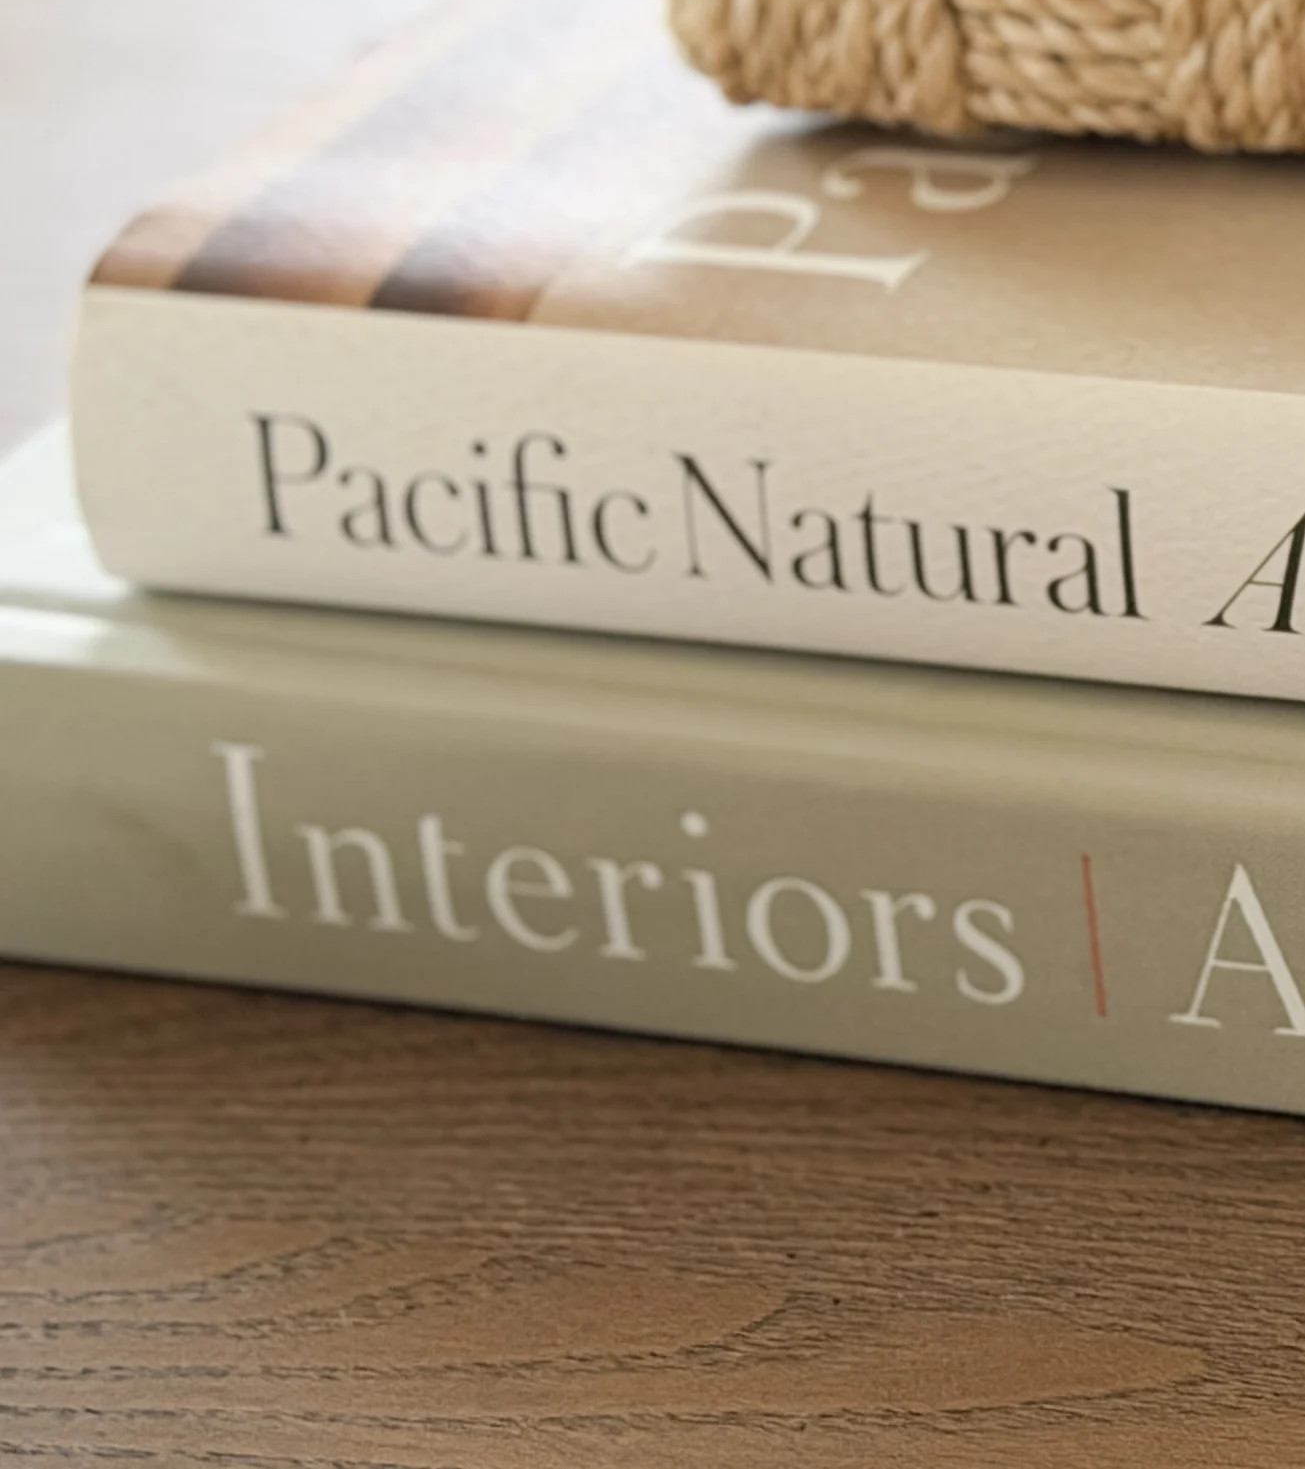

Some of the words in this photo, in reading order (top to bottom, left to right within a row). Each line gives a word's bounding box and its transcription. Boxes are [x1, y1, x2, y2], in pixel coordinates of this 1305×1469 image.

[248, 411, 658, 574] Pacific
[671, 452, 1151, 622] Natural
[211, 741, 1026, 1006] Interiors
